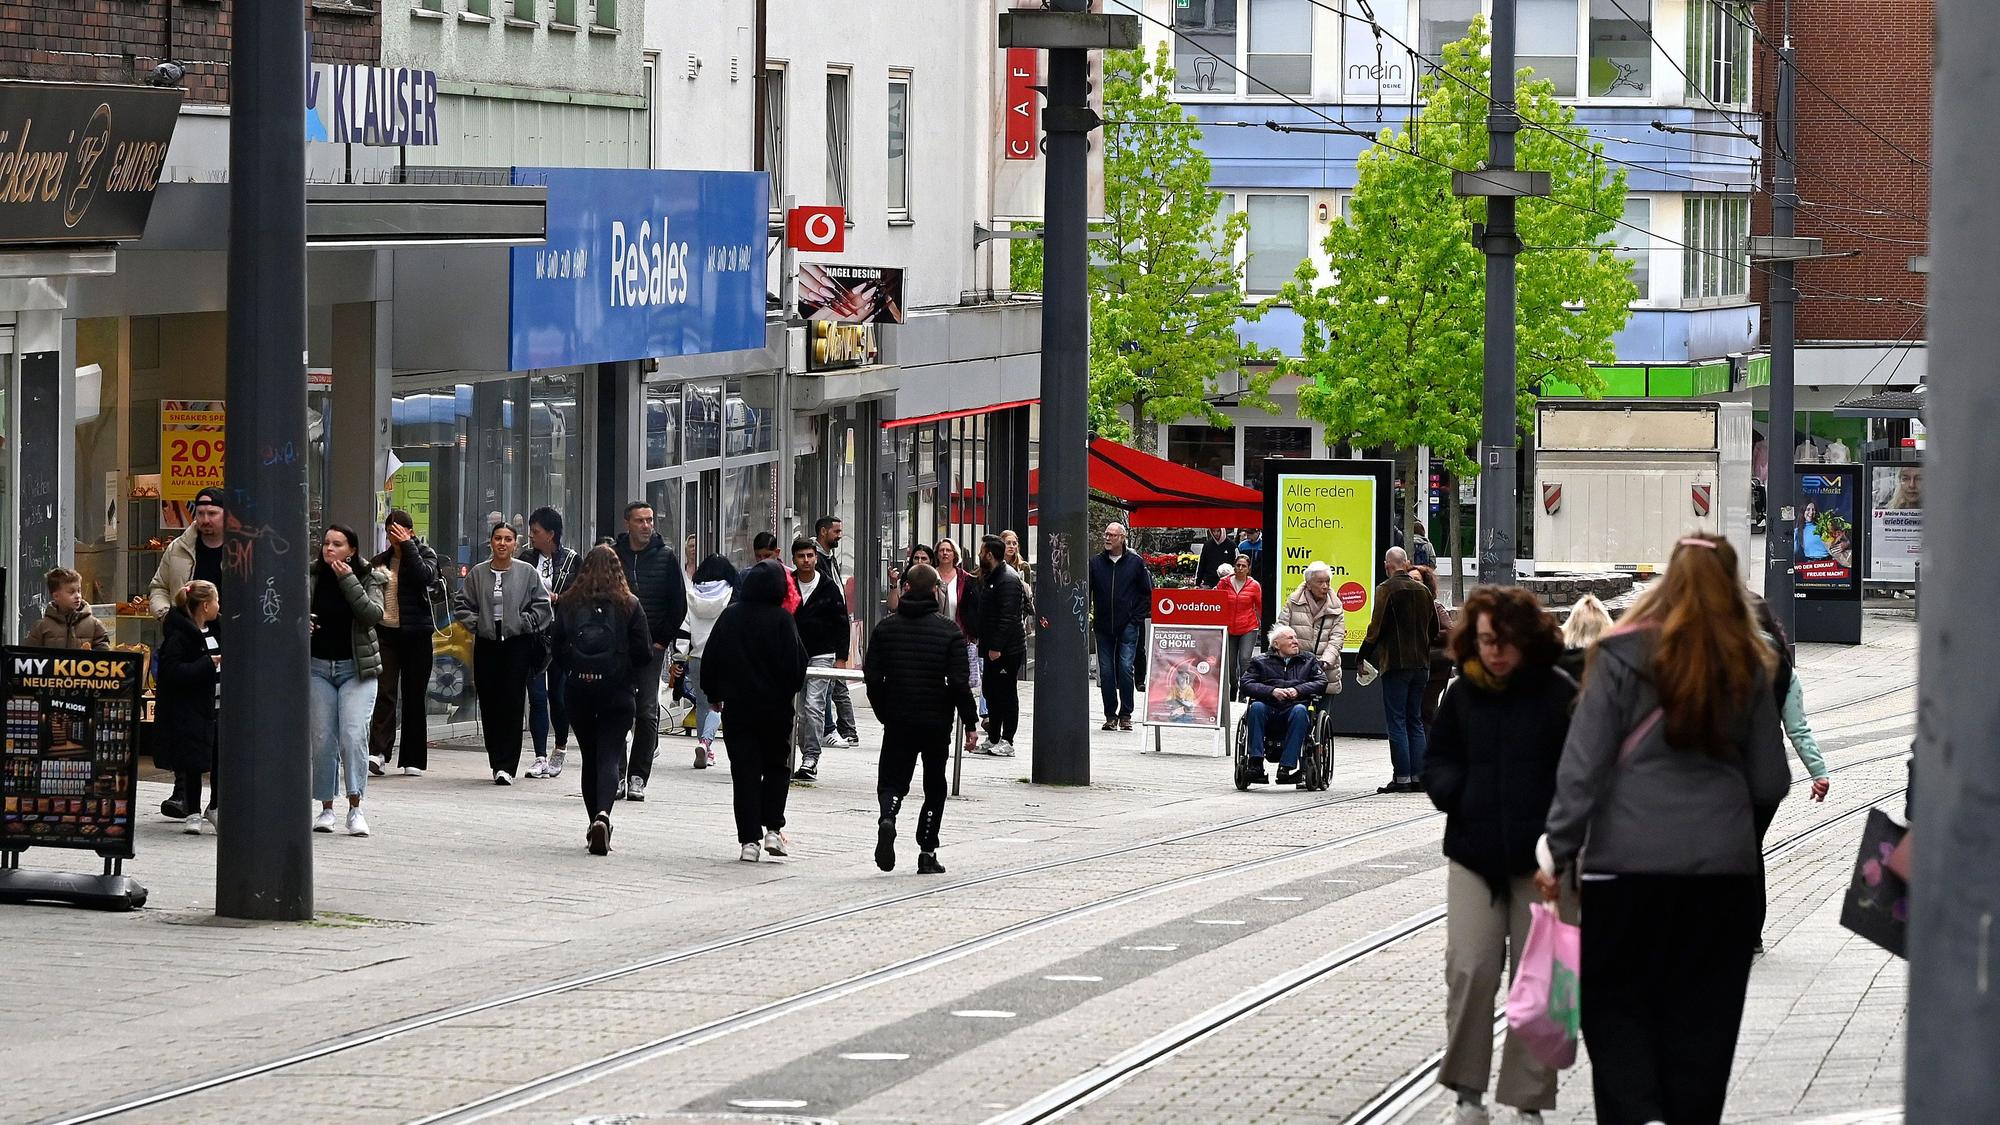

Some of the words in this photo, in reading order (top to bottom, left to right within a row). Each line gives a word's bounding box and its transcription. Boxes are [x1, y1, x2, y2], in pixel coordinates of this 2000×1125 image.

[1349, 61, 1402, 80] mein
[334, 64, 438, 146] KLAUSER
[1011, 66, 1030, 155] CAF
[610, 216, 689, 307] ReSales
[826, 267, 851, 278] NAGEL
[852, 268, 881, 279] DESIGN
[169, 414, 207, 422] SNEAKER
[1287, 484, 1311, 497] Alle
[1315, 484, 1354, 497] reden
[1287, 503, 1316, 512] vom
[1287, 516, 1344, 529] Machen.
[1287, 546, 1312, 559] Wir
[1287, 565, 1349, 576] maen.
[1176, 602, 1221, 612] vodafone
[15, 658, 48, 675] MY
[53, 659, 126, 678] KIOSK
[23, 677, 120, 690] NEUERÖFFNUNG
[51, 699, 65, 708] MY
[66, 702, 87, 713] KIOSK
